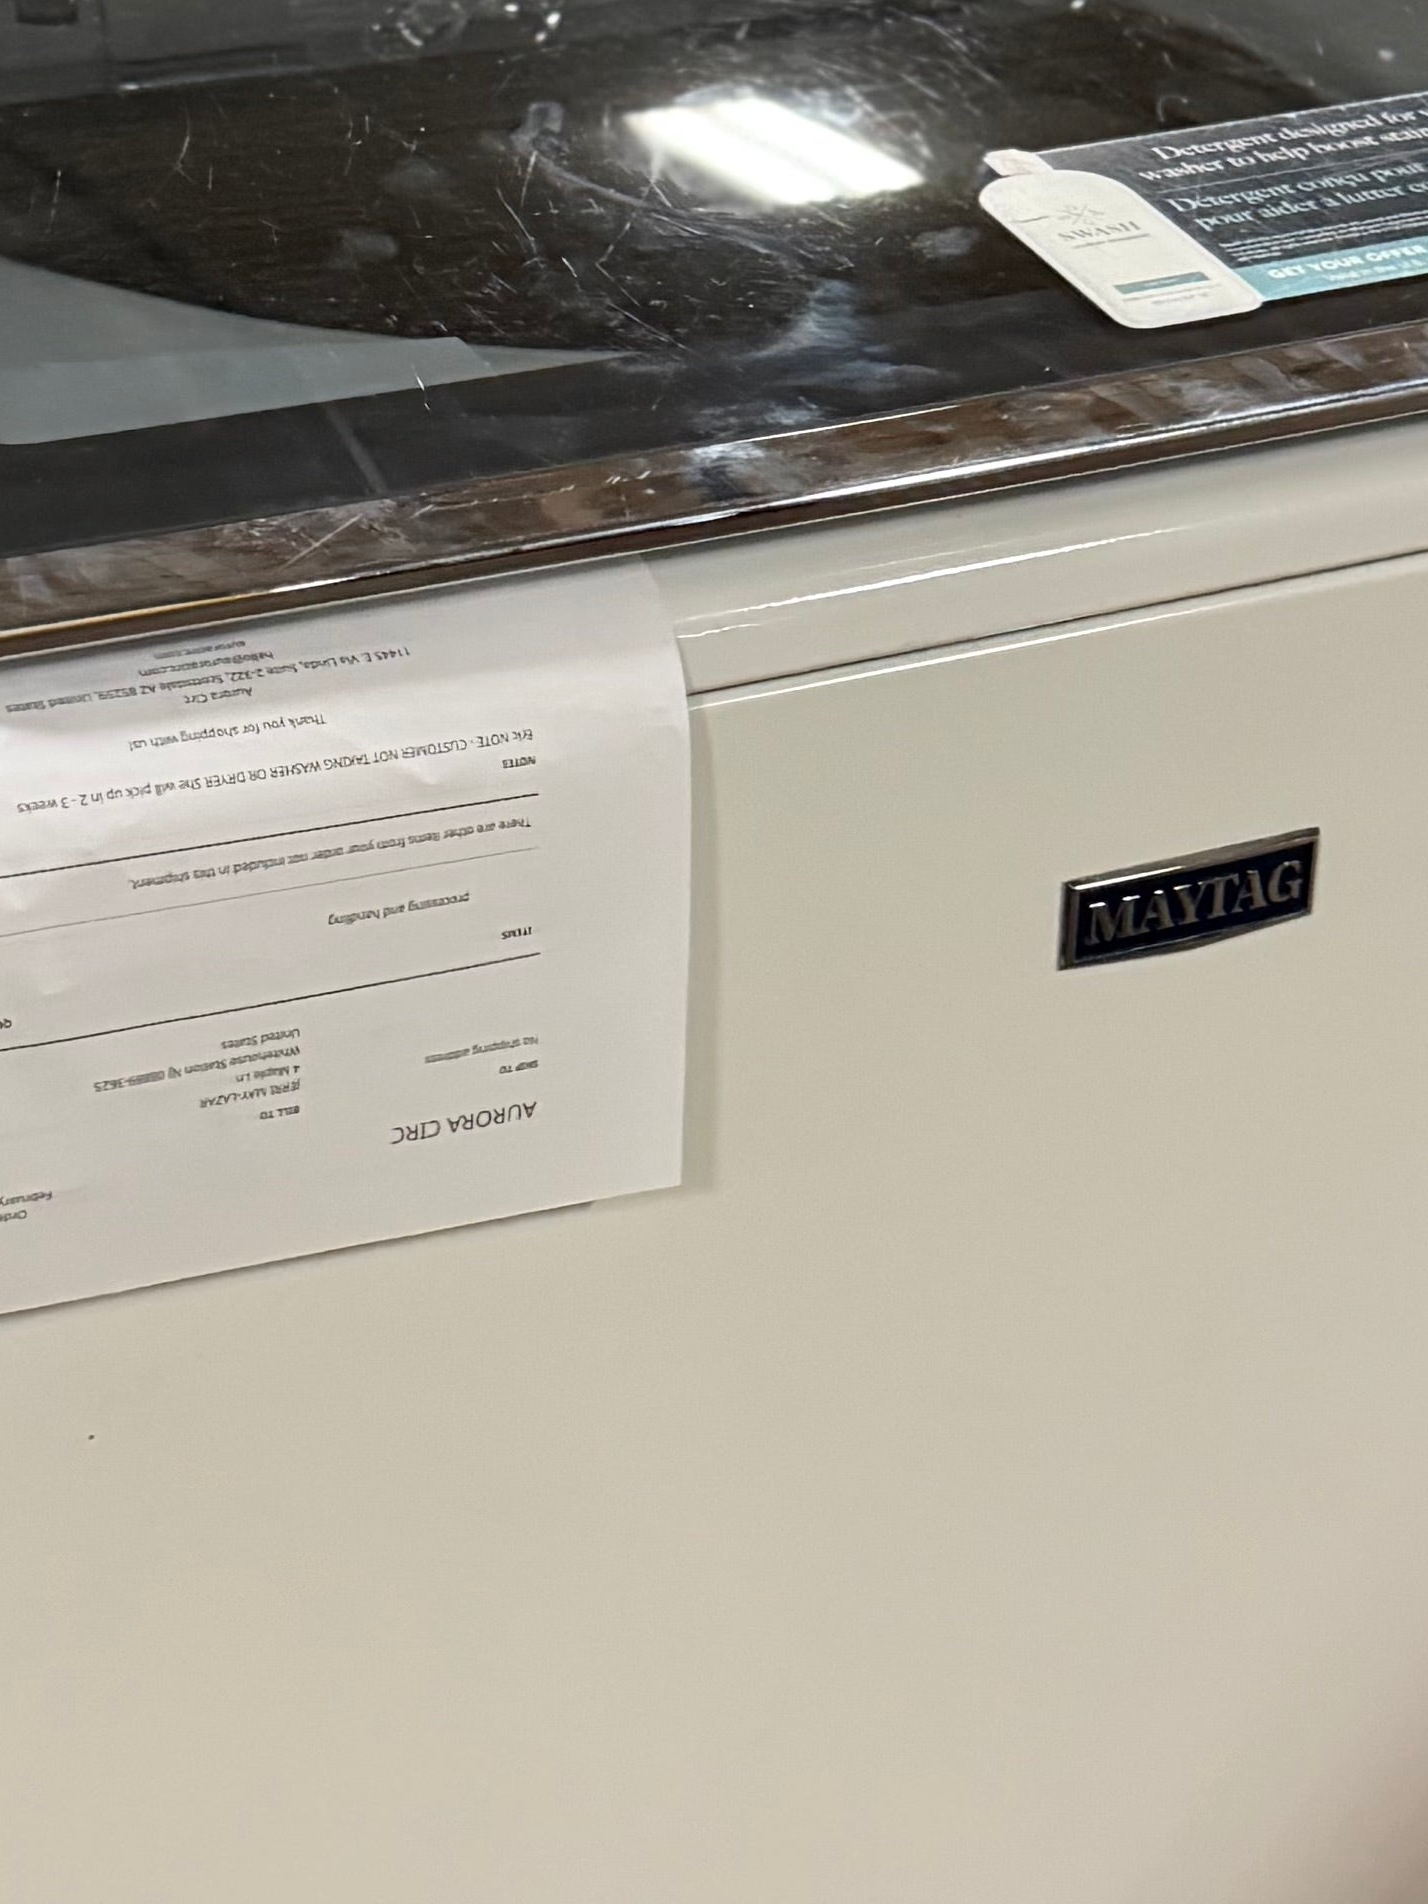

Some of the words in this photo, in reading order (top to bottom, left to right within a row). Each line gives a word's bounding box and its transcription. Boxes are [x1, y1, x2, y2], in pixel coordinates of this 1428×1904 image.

[1150, 131, 1278, 161] Detergent
[1278, 112, 1383, 142] designed
[1381, 108, 1416, 125] for
[1138, 158, 1224, 182] washer
[1226, 154, 1257, 169] to
[1255, 142, 1311, 161] help
[1307, 134, 1381, 155] boost
[1371, 161, 1423, 183] pour
[1194, 209, 1256, 233] pour
[1258, 197, 1323, 219] aider
[1337, 185, 1405, 207] lutter
[1266, 264, 1304, 279] GET
[1306, 254, 1365, 271] YOUR
[339, 654, 361, 666] Via
[242, 723, 260, 735] for
[262, 715, 286, 730] you
[286, 712, 327, 730] Thank
[149, 734, 180, 749] with
[178, 726, 239, 744] shopping
[476, 732, 509, 748] NOTE
[128, 738, 148, 752] us!
[400, 738, 468, 759] CUSTOMER
[323, 752, 371, 771] TAKING
[372, 749, 398, 764] NOT
[501, 755, 537, 769] NOTES
[248, 768, 267, 781] OR
[269, 760, 322, 780] WASHER
[153, 781, 176, 796] will
[178, 777, 202, 791] She
[203, 771, 246, 789] DRYER
[90, 791, 105, 804] in
[106, 787, 123, 800] up
[124, 782, 152, 798] pick
[16, 798, 58, 815] weeks
[60, 796, 71, 810] 3
[78, 793, 88, 807] 2
[498, 817, 532, 831] There
[382, 904, 406, 917] and
[406, 892, 470, 914] processing
[1083, 859, 1304, 945] MAYTAG
[327, 906, 381, 927] handling
[220, 1034, 258, 1051] States
[260, 1027, 301, 1045] United
[228, 1045, 301, 1067] Whitehouse
[184, 1058, 228, 1076] Station
[259, 1110, 275, 1121] TO
[277, 1104, 301, 1118] BILL
[446, 1100, 538, 1134] AURORA
[388, 1119, 442, 1145] CIRC
